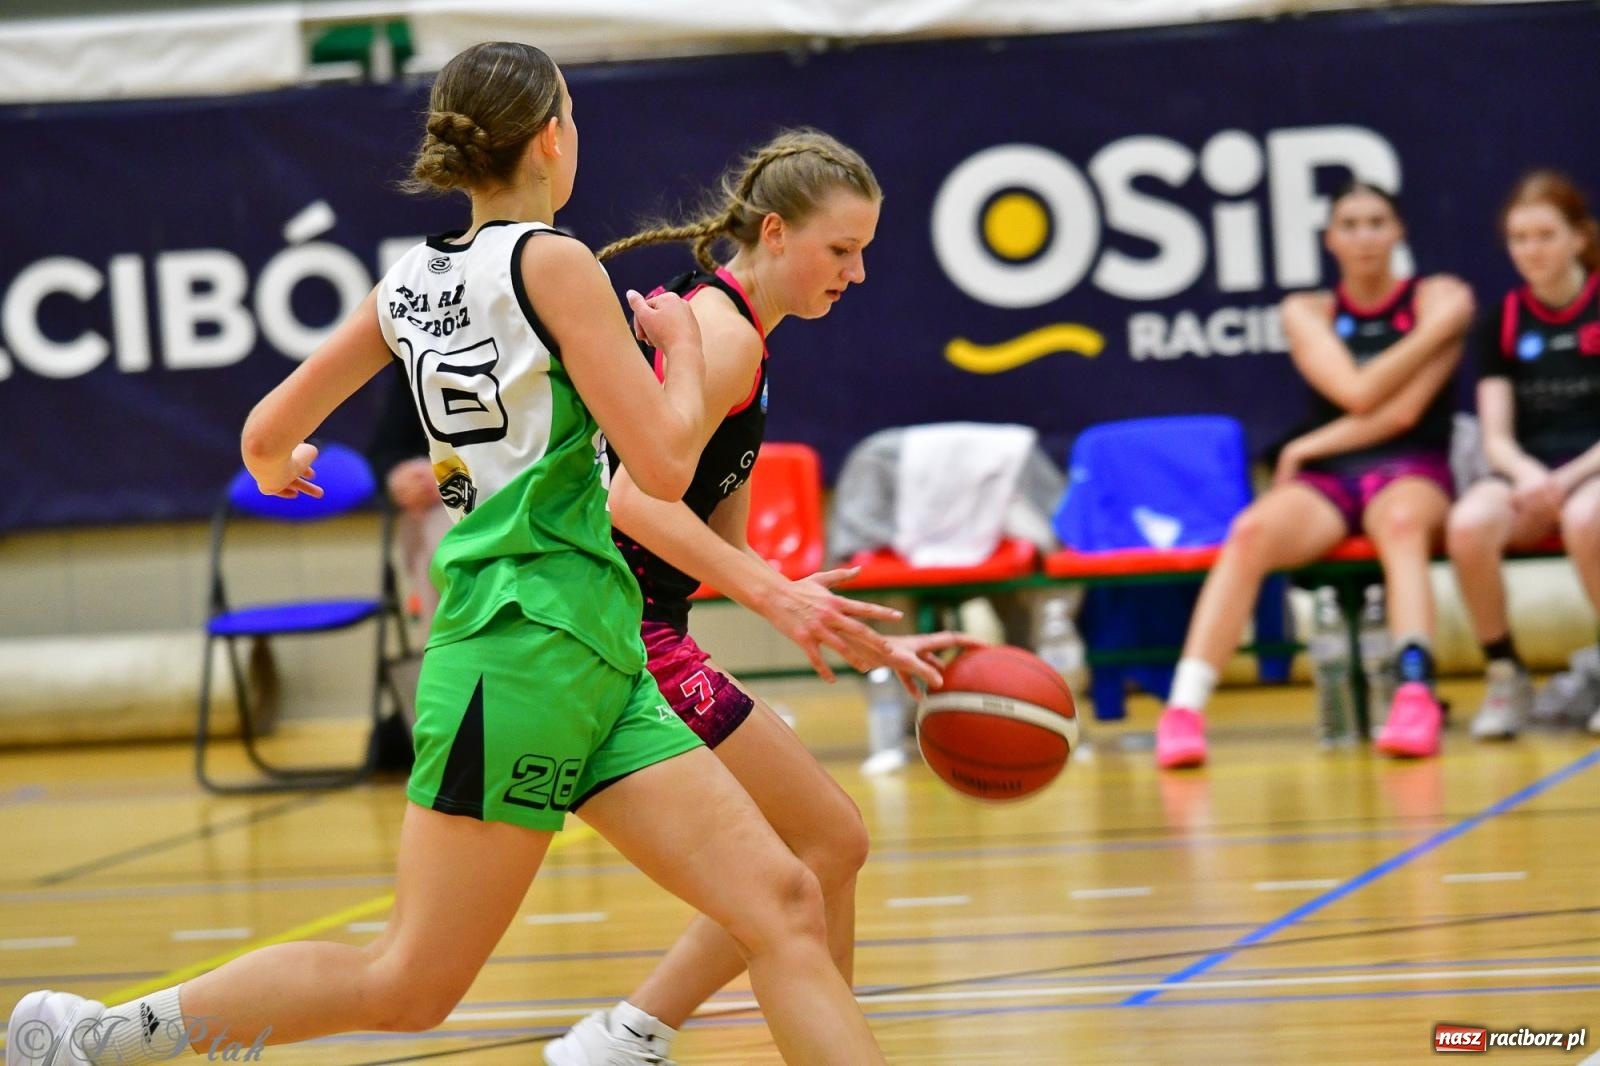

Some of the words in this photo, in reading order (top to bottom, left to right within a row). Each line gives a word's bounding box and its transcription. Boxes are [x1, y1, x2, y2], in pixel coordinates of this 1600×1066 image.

[931, 124, 1416, 308] OSiR
[0, 201, 422, 380] CIBÓ
[680, 670, 716, 716] 7
[503, 753, 582, 811] 26
